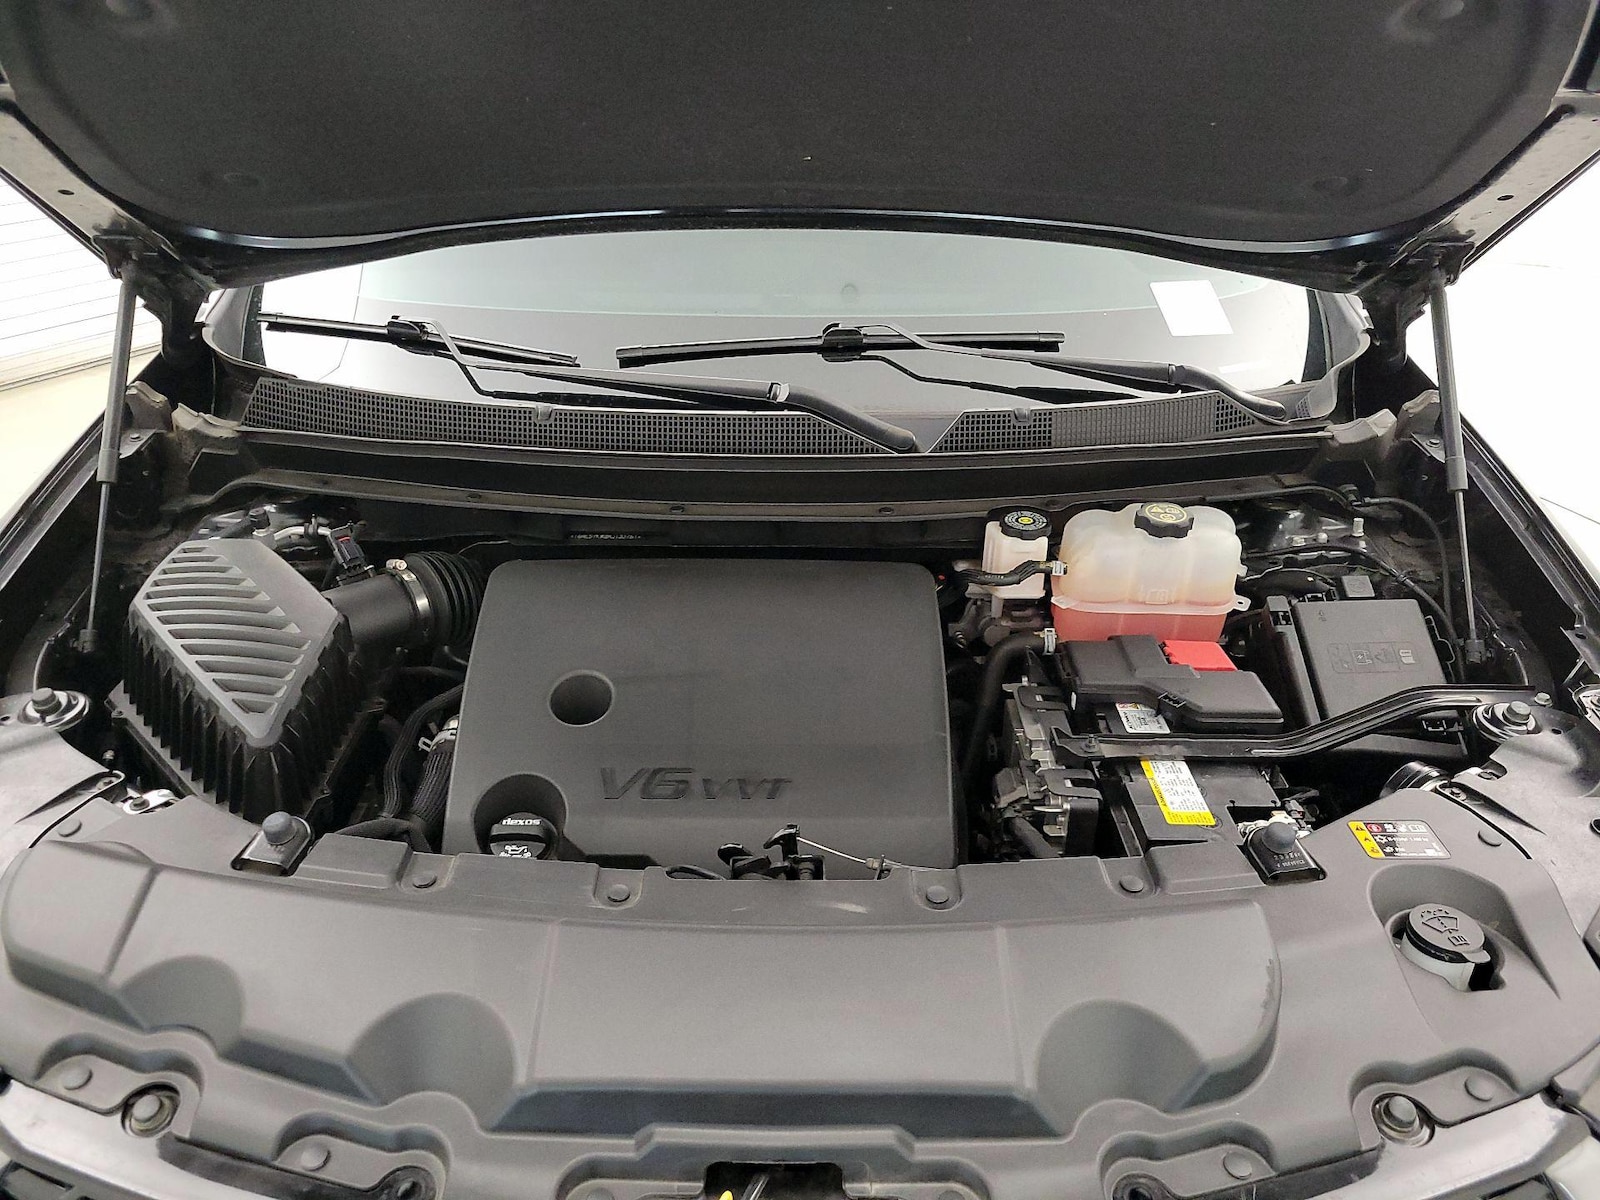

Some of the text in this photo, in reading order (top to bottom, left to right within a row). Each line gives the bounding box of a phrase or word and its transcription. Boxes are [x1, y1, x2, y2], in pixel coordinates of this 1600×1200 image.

[600, 767, 792, 800] V6 VVT
[502, 817, 542, 826] dexos
